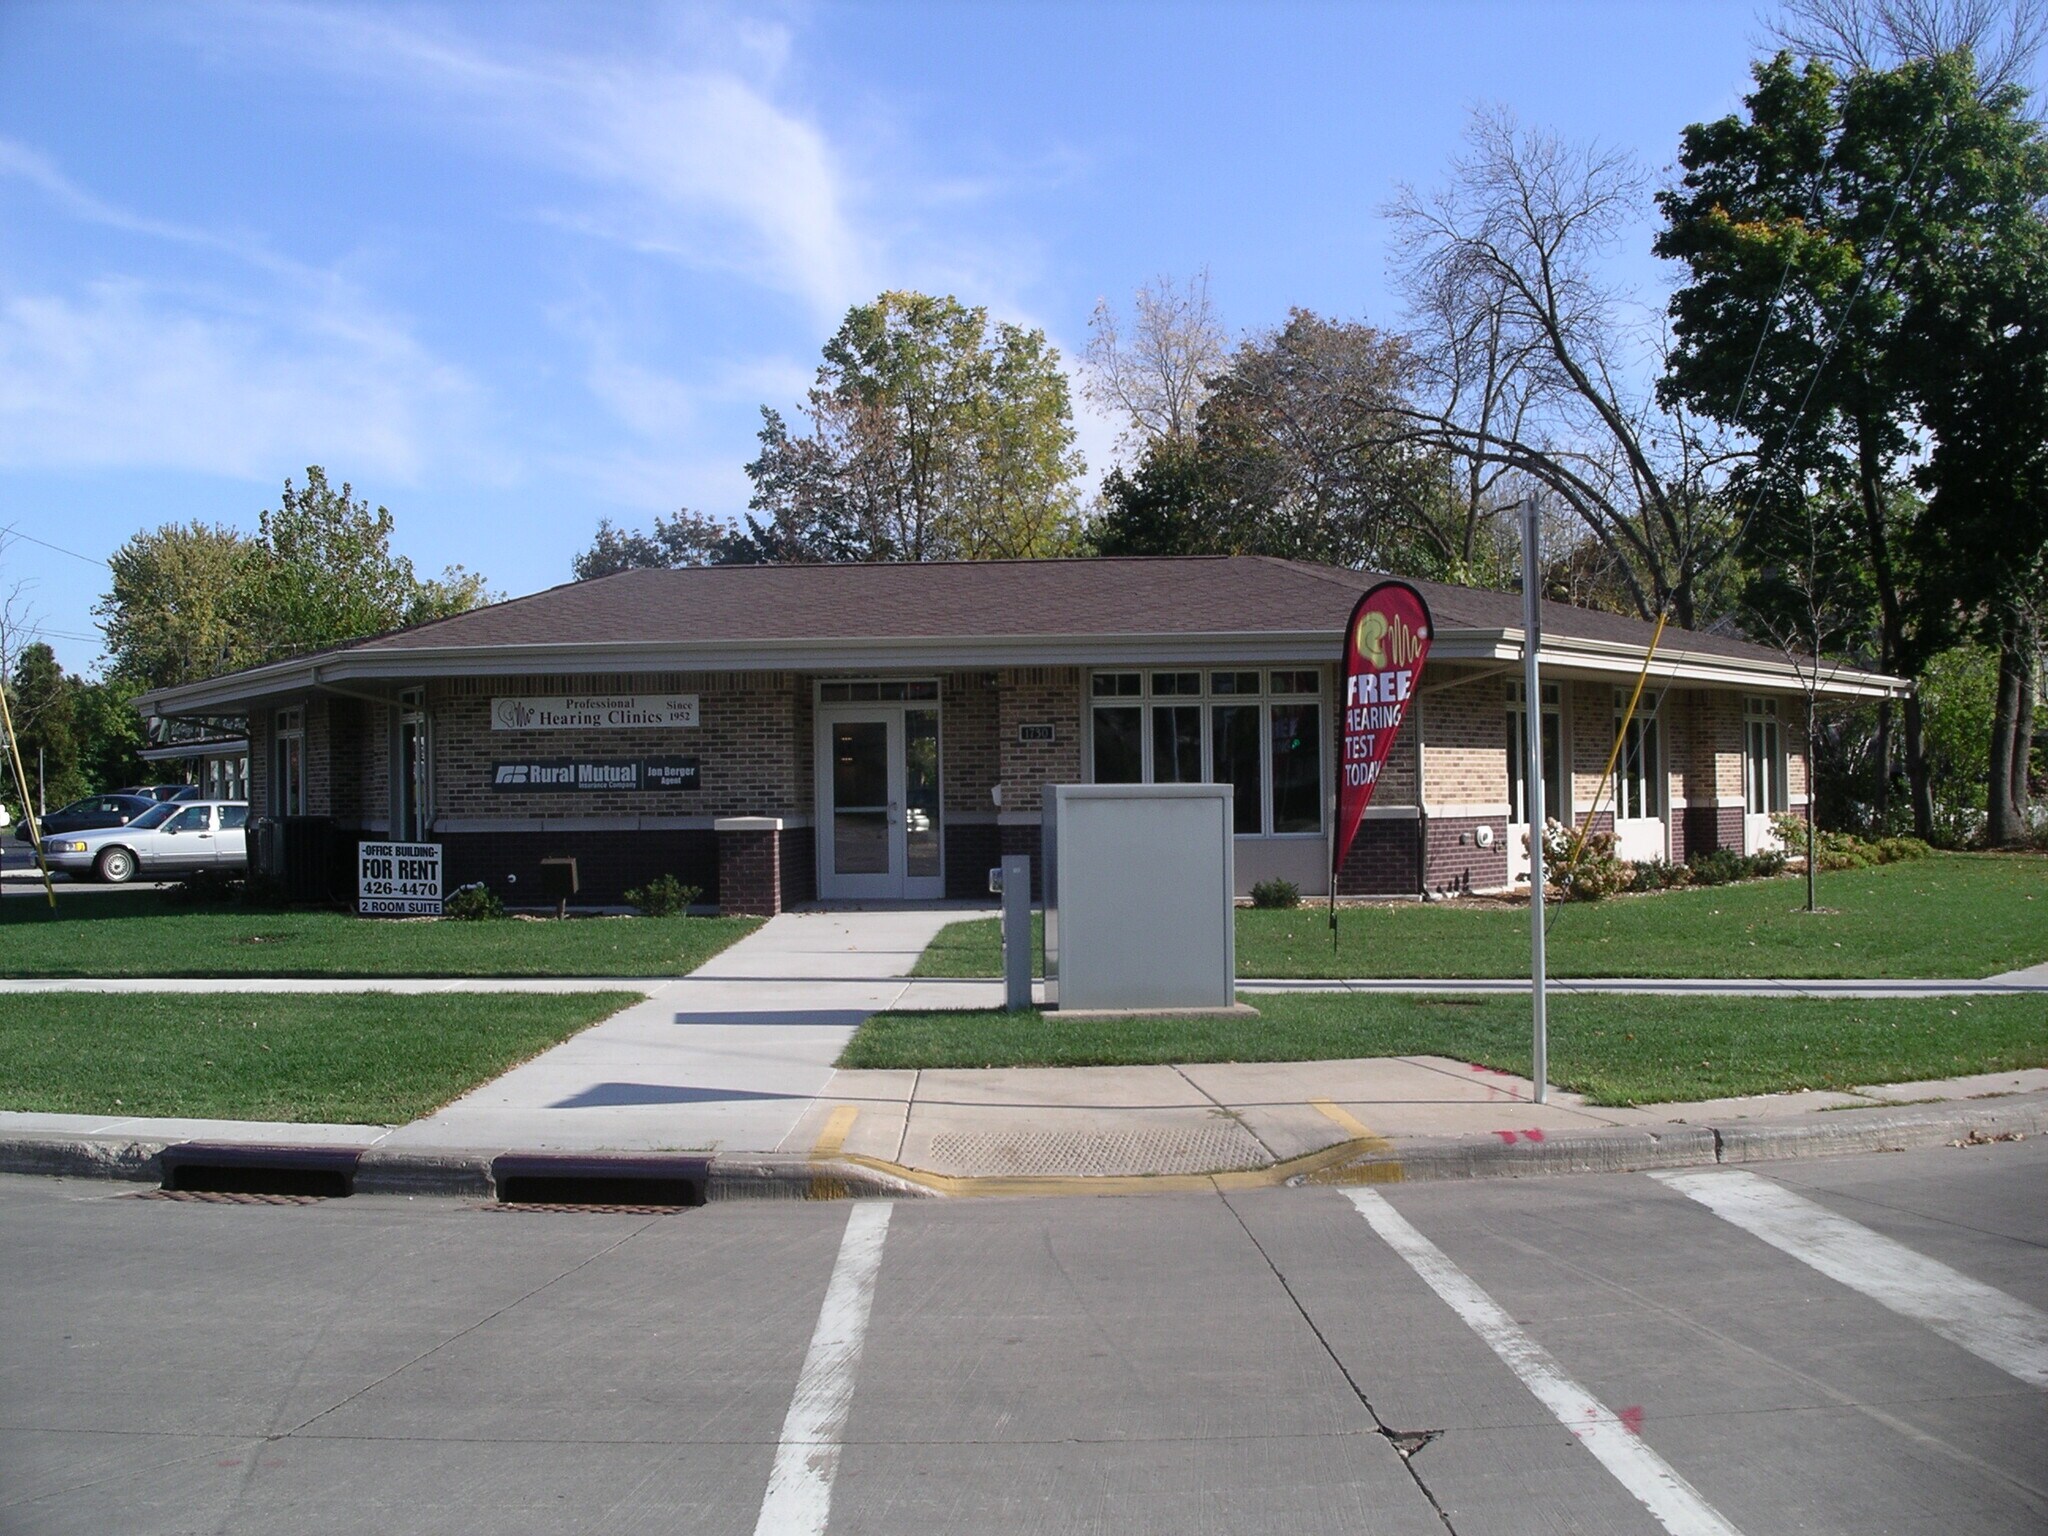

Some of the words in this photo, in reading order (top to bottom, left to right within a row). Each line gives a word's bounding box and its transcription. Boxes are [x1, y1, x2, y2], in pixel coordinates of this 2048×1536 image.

[1347, 670, 1412, 706] FREE
[566, 698, 635, 709] Professional
[666, 701, 693, 710] Since
[540, 711, 601, 727] Hearing
[608, 710, 663, 724] Clinics
[670, 712, 690, 721] 1952
[1345, 734, 1375, 759] TEST
[530, 765, 575, 783] Rural
[579, 763, 637, 782] Mutual
[664, 767, 695, 777] Berger
[608, 781, 636, 789] Company
[661, 777, 681, 785] Agent
[362, 859, 393, 879] FOR
[399, 860, 438, 880] RENT
[363, 882, 438, 896] 426-4470
[362, 902, 368, 911] 2
[372, 902, 405, 911] ROOM
[408, 903, 440, 912] SUITE
